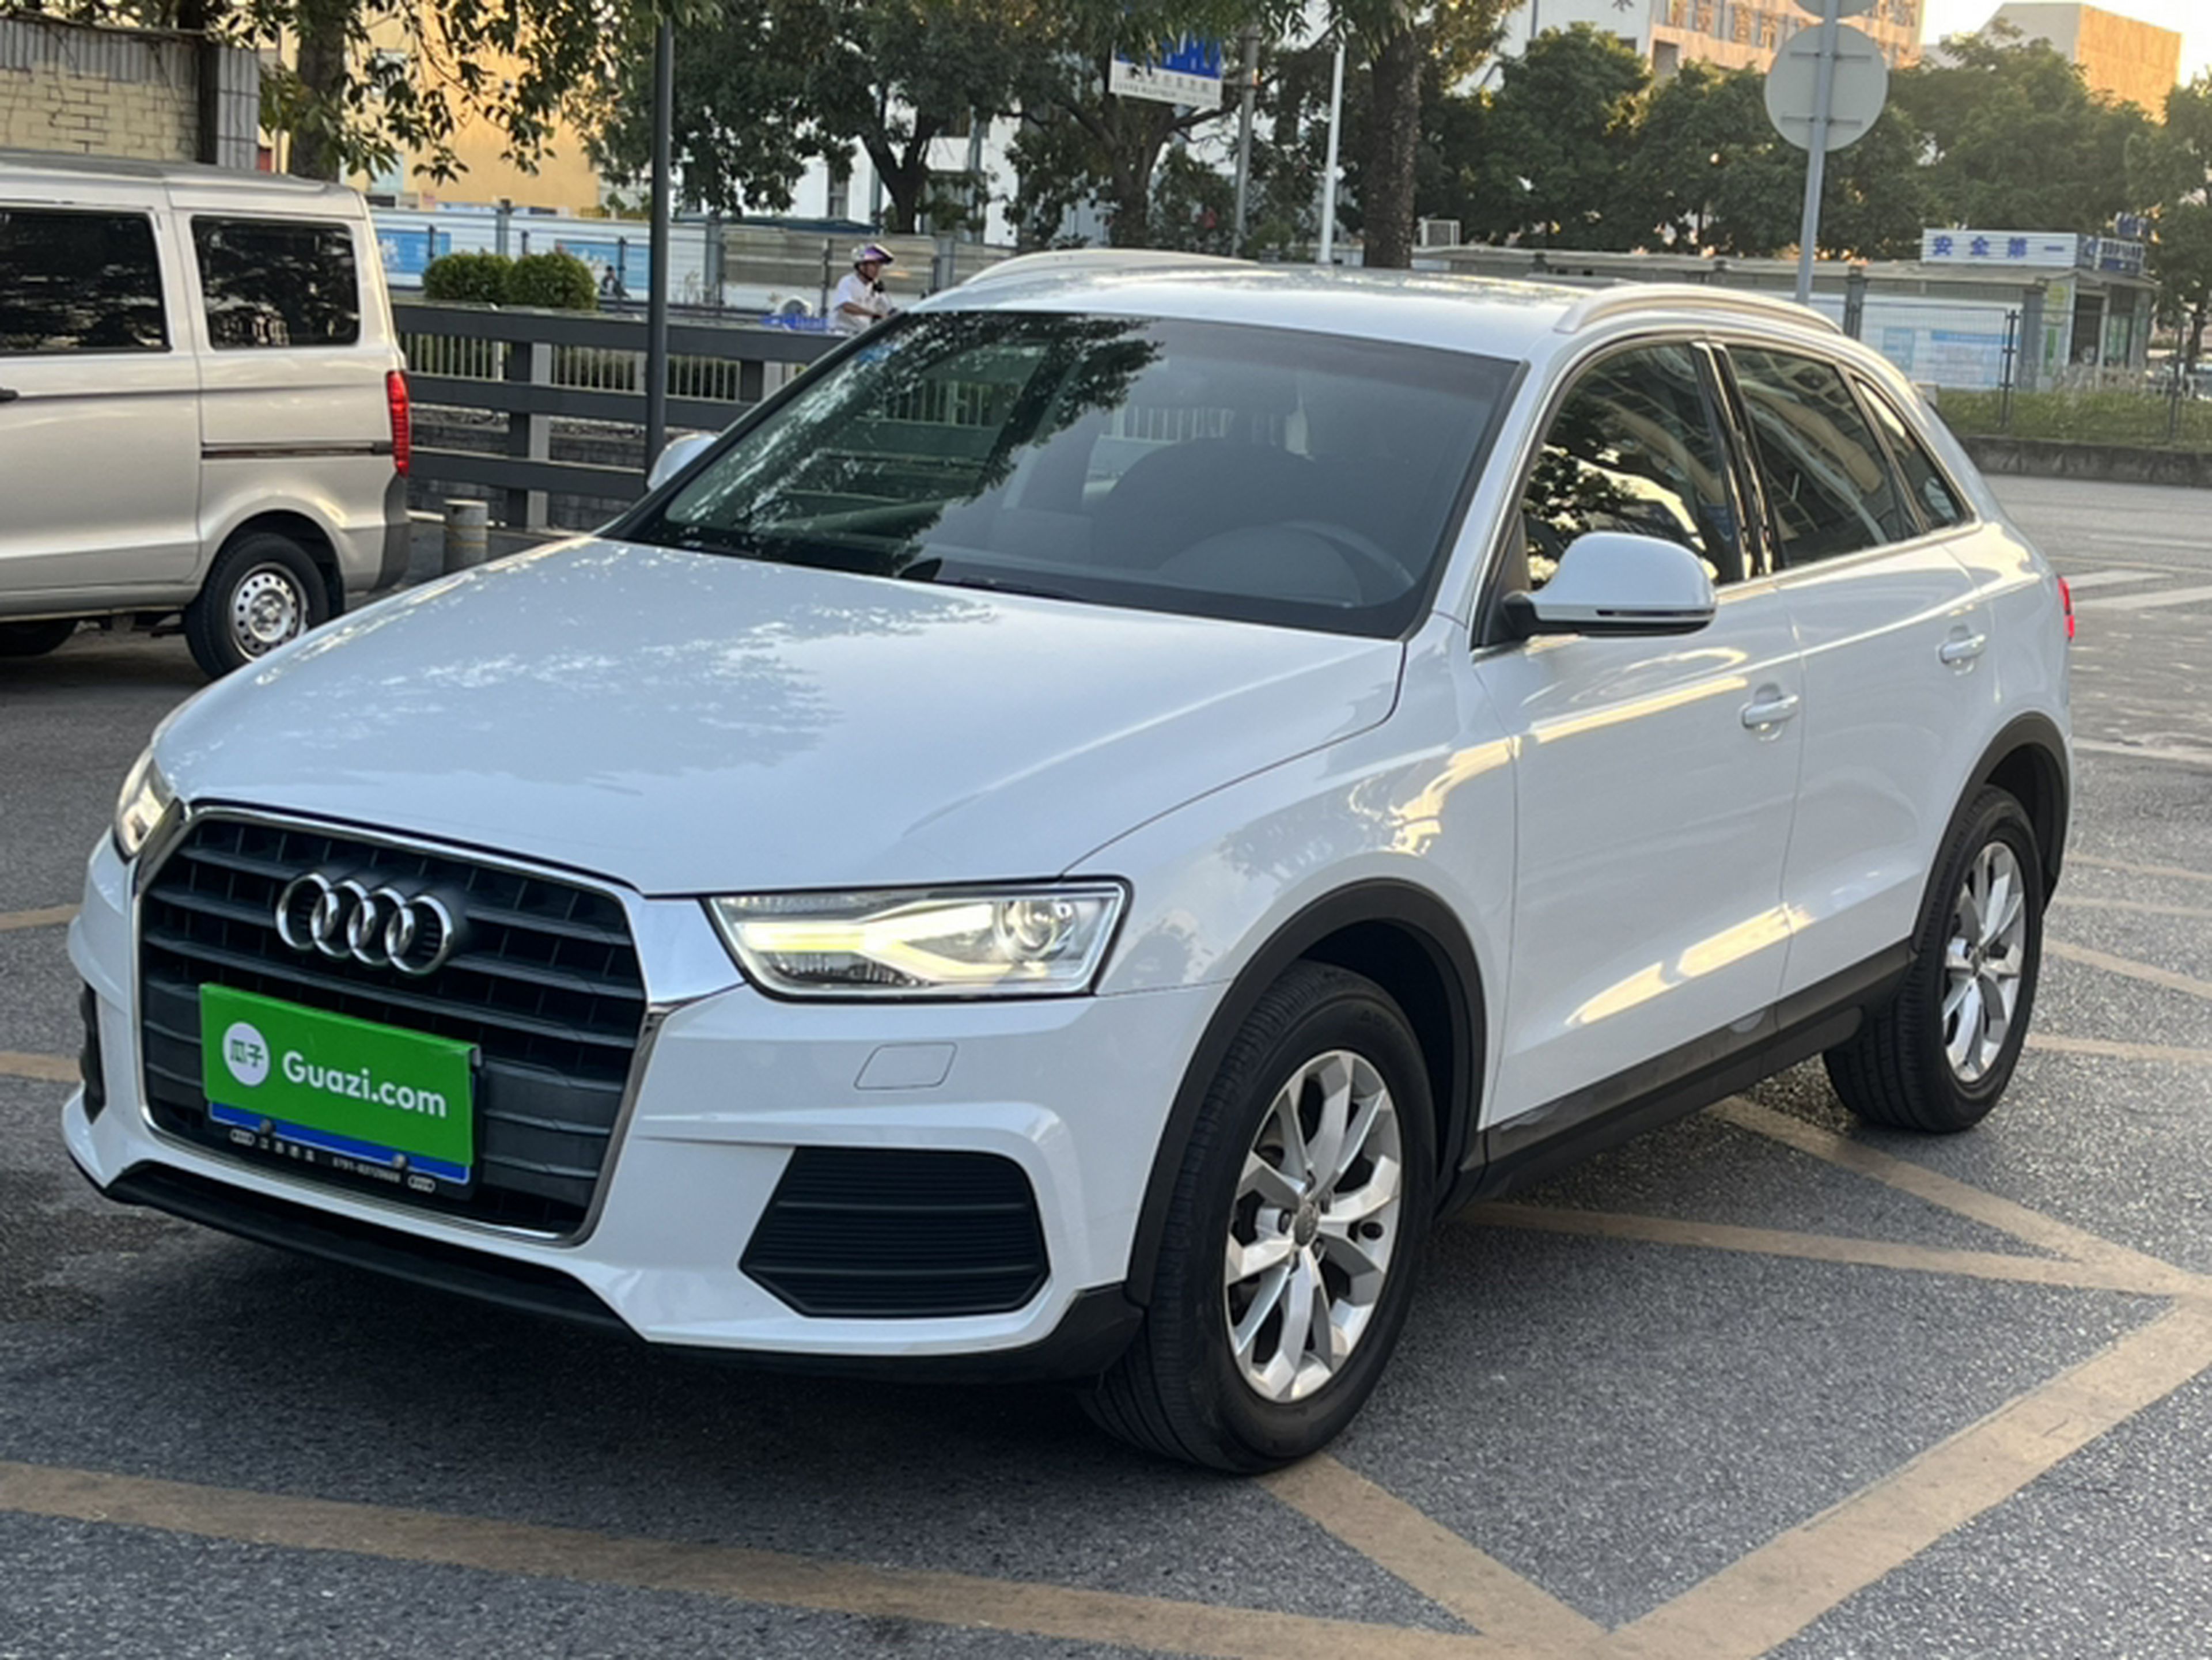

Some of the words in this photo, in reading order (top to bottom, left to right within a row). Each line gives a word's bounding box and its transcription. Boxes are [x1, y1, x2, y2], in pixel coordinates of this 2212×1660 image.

[1933, 236, 2064, 257] 安全第一
[230, 1039, 263, 1067] 瓜子
[282, 1050, 446, 1118] Guazi.com
